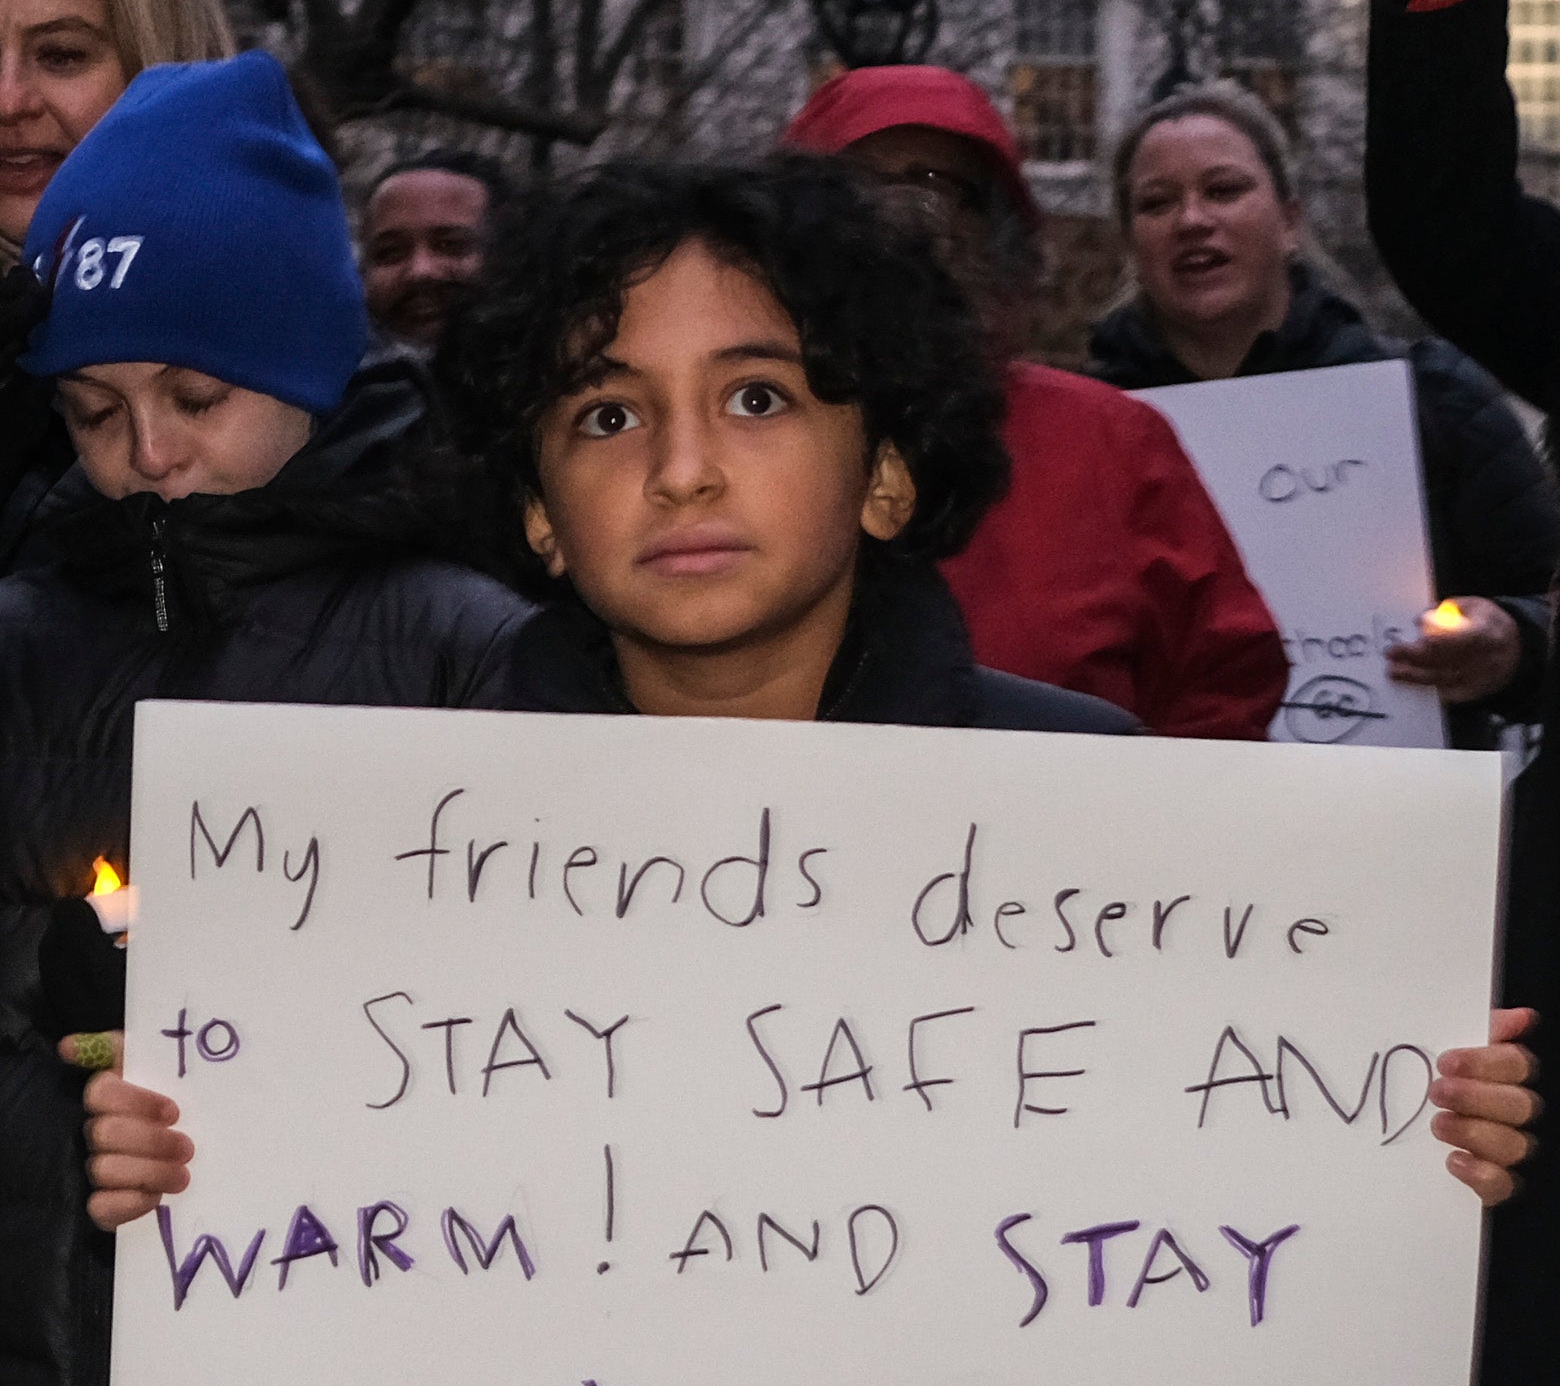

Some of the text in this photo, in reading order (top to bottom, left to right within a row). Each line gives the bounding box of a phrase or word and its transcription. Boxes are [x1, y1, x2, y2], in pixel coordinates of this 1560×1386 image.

[189, 787, 1332, 960] My friends deserve
[176, 989, 1440, 1147] to STAY SAFE AND
[668, 1203, 899, 1297] AND
[993, 1212, 1302, 1329] STAY
